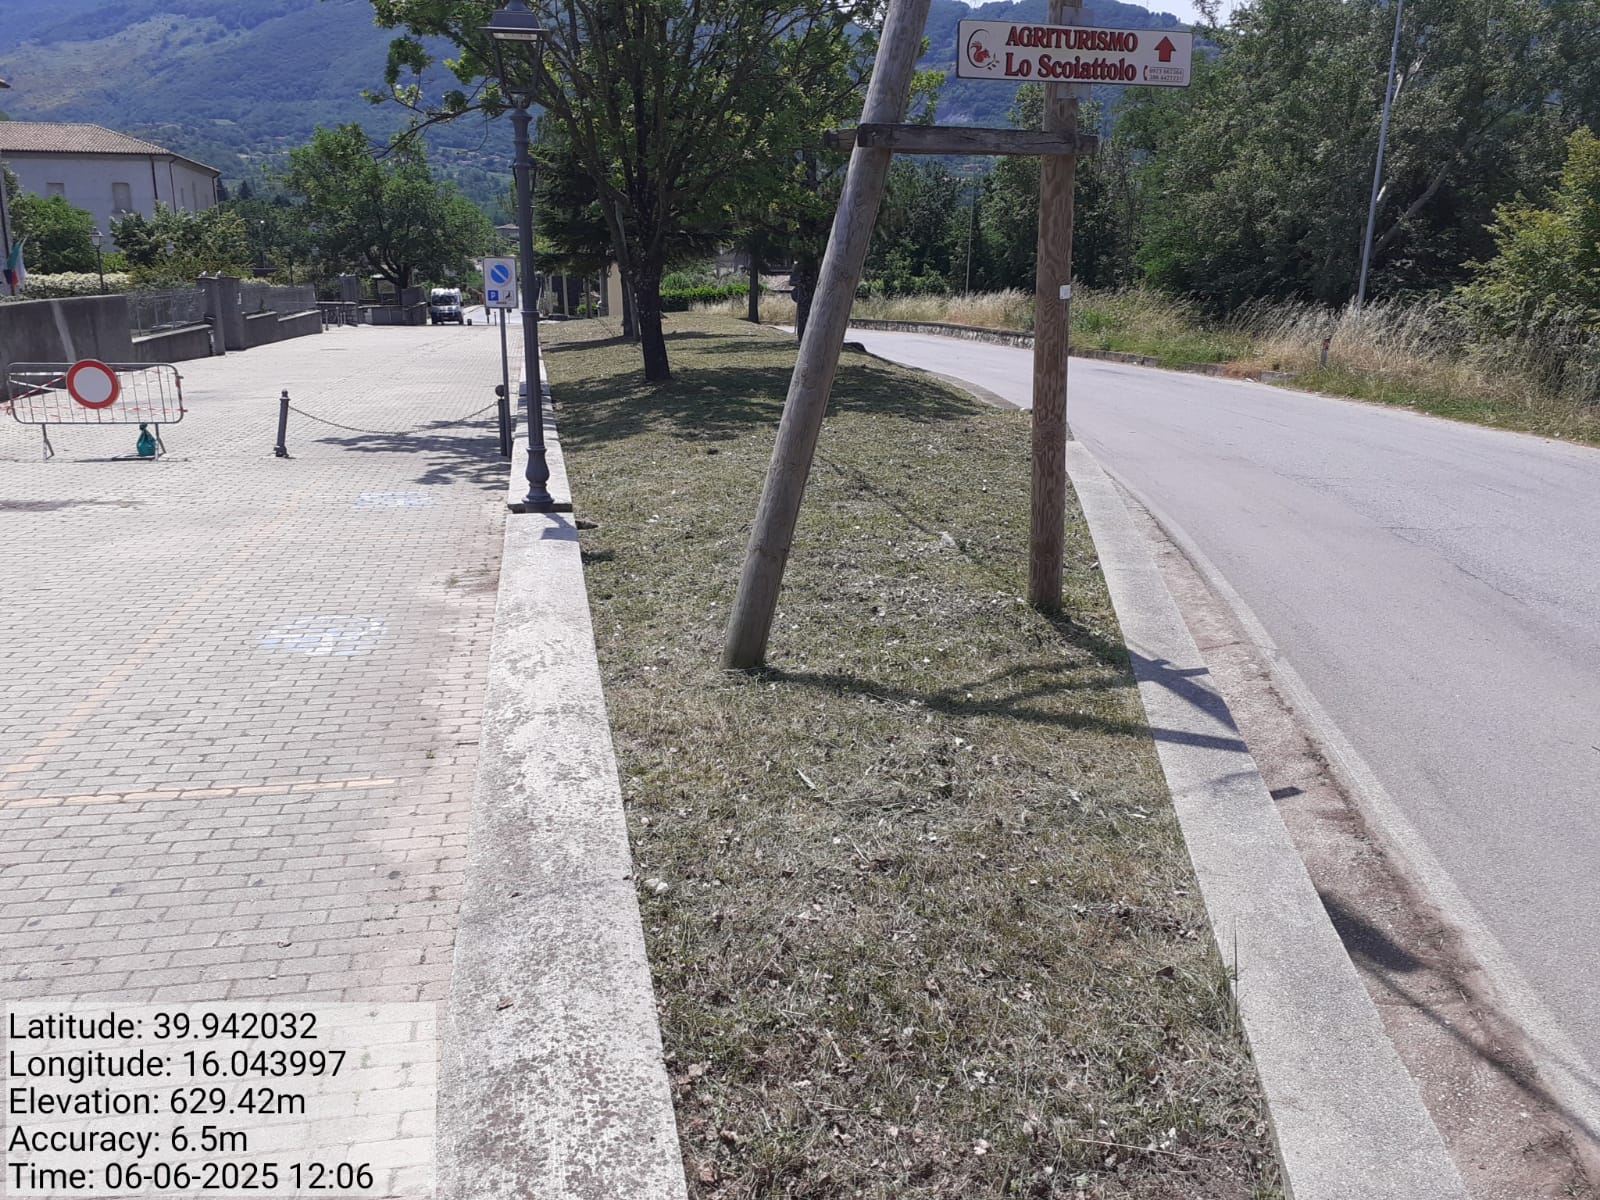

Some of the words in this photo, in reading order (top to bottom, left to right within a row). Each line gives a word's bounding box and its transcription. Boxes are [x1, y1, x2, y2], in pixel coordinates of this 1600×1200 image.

[1006, 26, 1138, 52] AGRITURISMO
[1005, 53, 1031, 77] Lo
[1038, 54, 1137, 81] Scoiattolo
